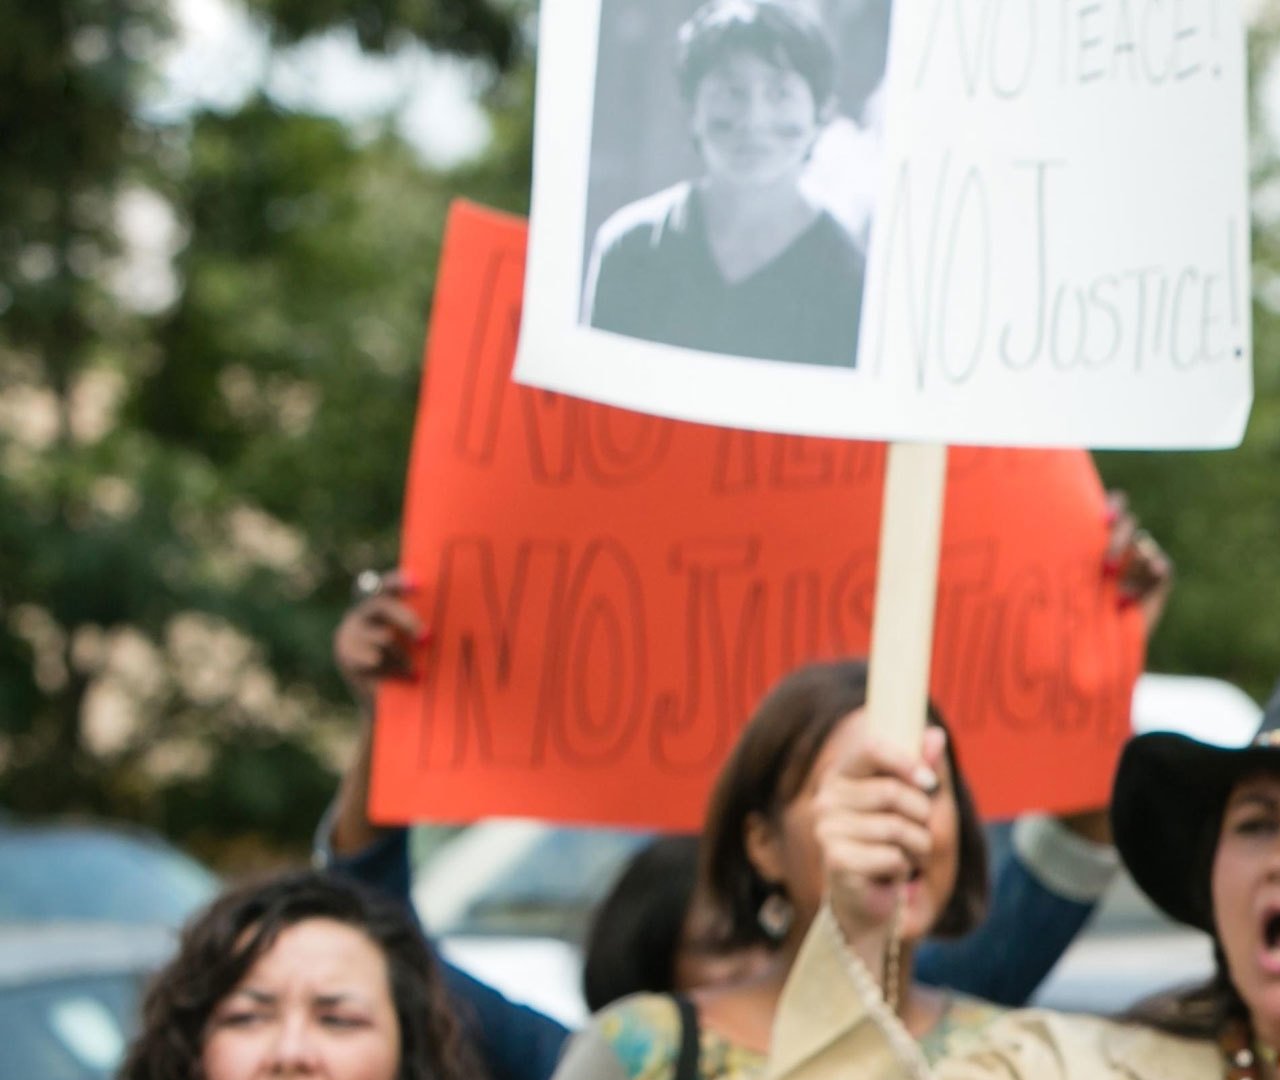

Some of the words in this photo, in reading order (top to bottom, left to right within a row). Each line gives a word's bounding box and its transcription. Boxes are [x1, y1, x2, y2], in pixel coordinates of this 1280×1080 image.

[872, 145, 994, 397] NO
[997, 156, 1246, 374] JUSTICE!
[418, 533, 649, 773] NO
